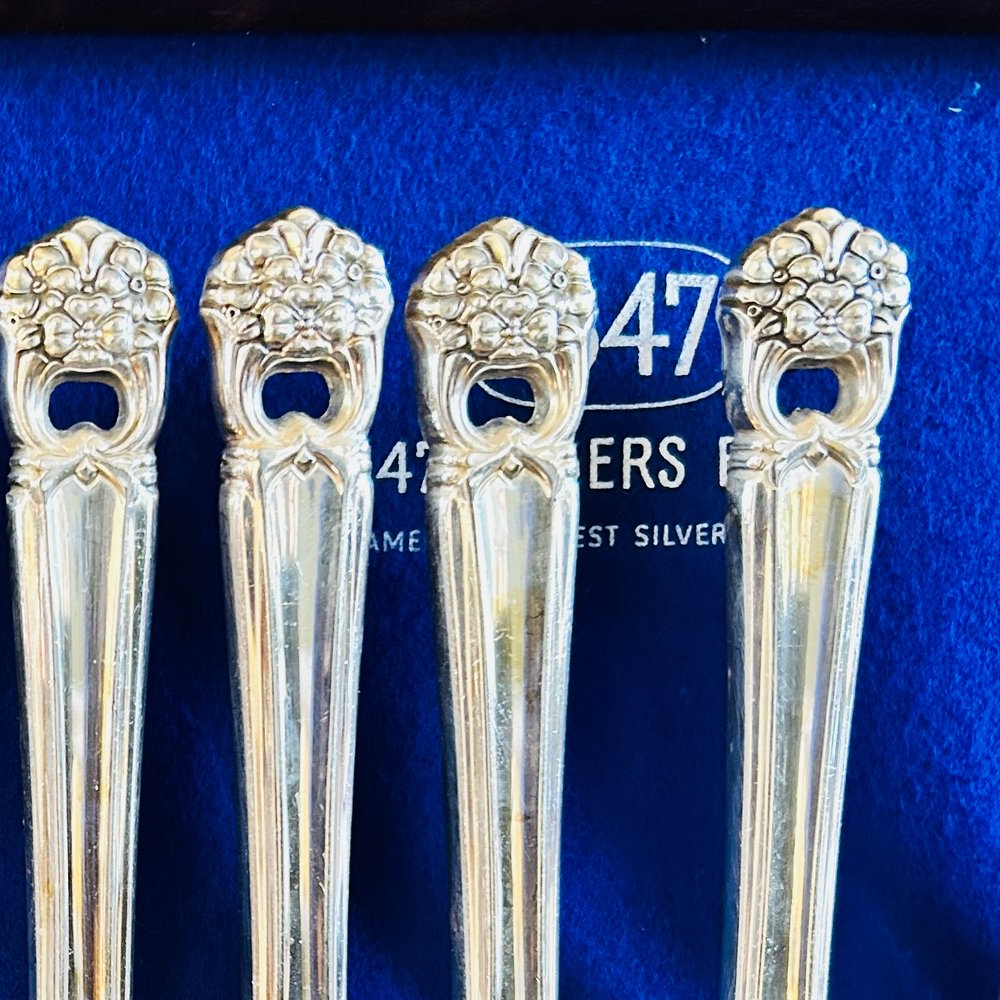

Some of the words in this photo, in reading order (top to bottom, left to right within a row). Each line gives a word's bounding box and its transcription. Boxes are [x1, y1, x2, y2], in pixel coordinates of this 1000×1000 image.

[587, 270, 719, 377] 47
[589, 435, 687, 490] ERS
[634, 522, 726, 547] SILVER
